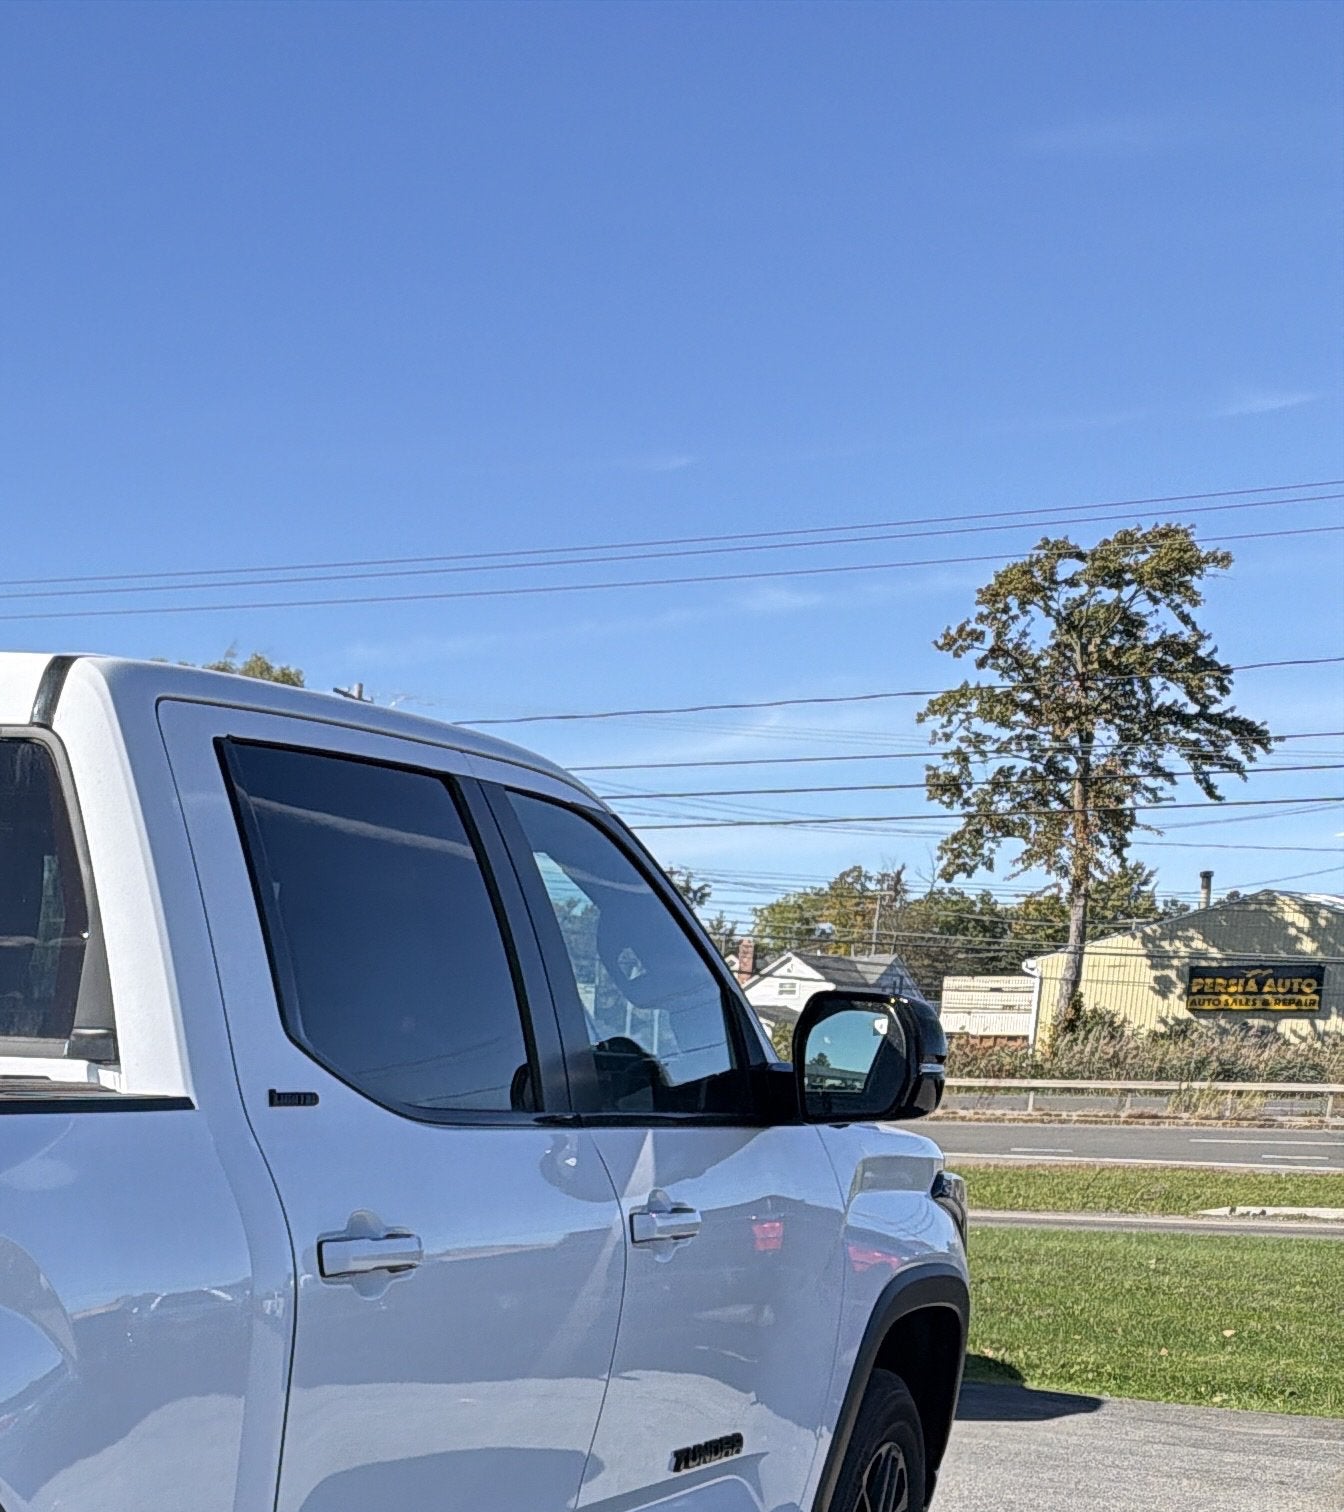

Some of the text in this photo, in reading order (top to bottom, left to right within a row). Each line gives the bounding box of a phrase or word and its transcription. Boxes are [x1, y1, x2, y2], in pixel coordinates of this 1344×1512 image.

[1190, 977, 1318, 994] PERSIA AUTO
[1189, 998, 1221, 1007] AUTO
[1223, 998, 1258, 1007] SALES
[1273, 998, 1318, 1008] REPAIR
[672, 1432, 744, 1473] TUNDRA
